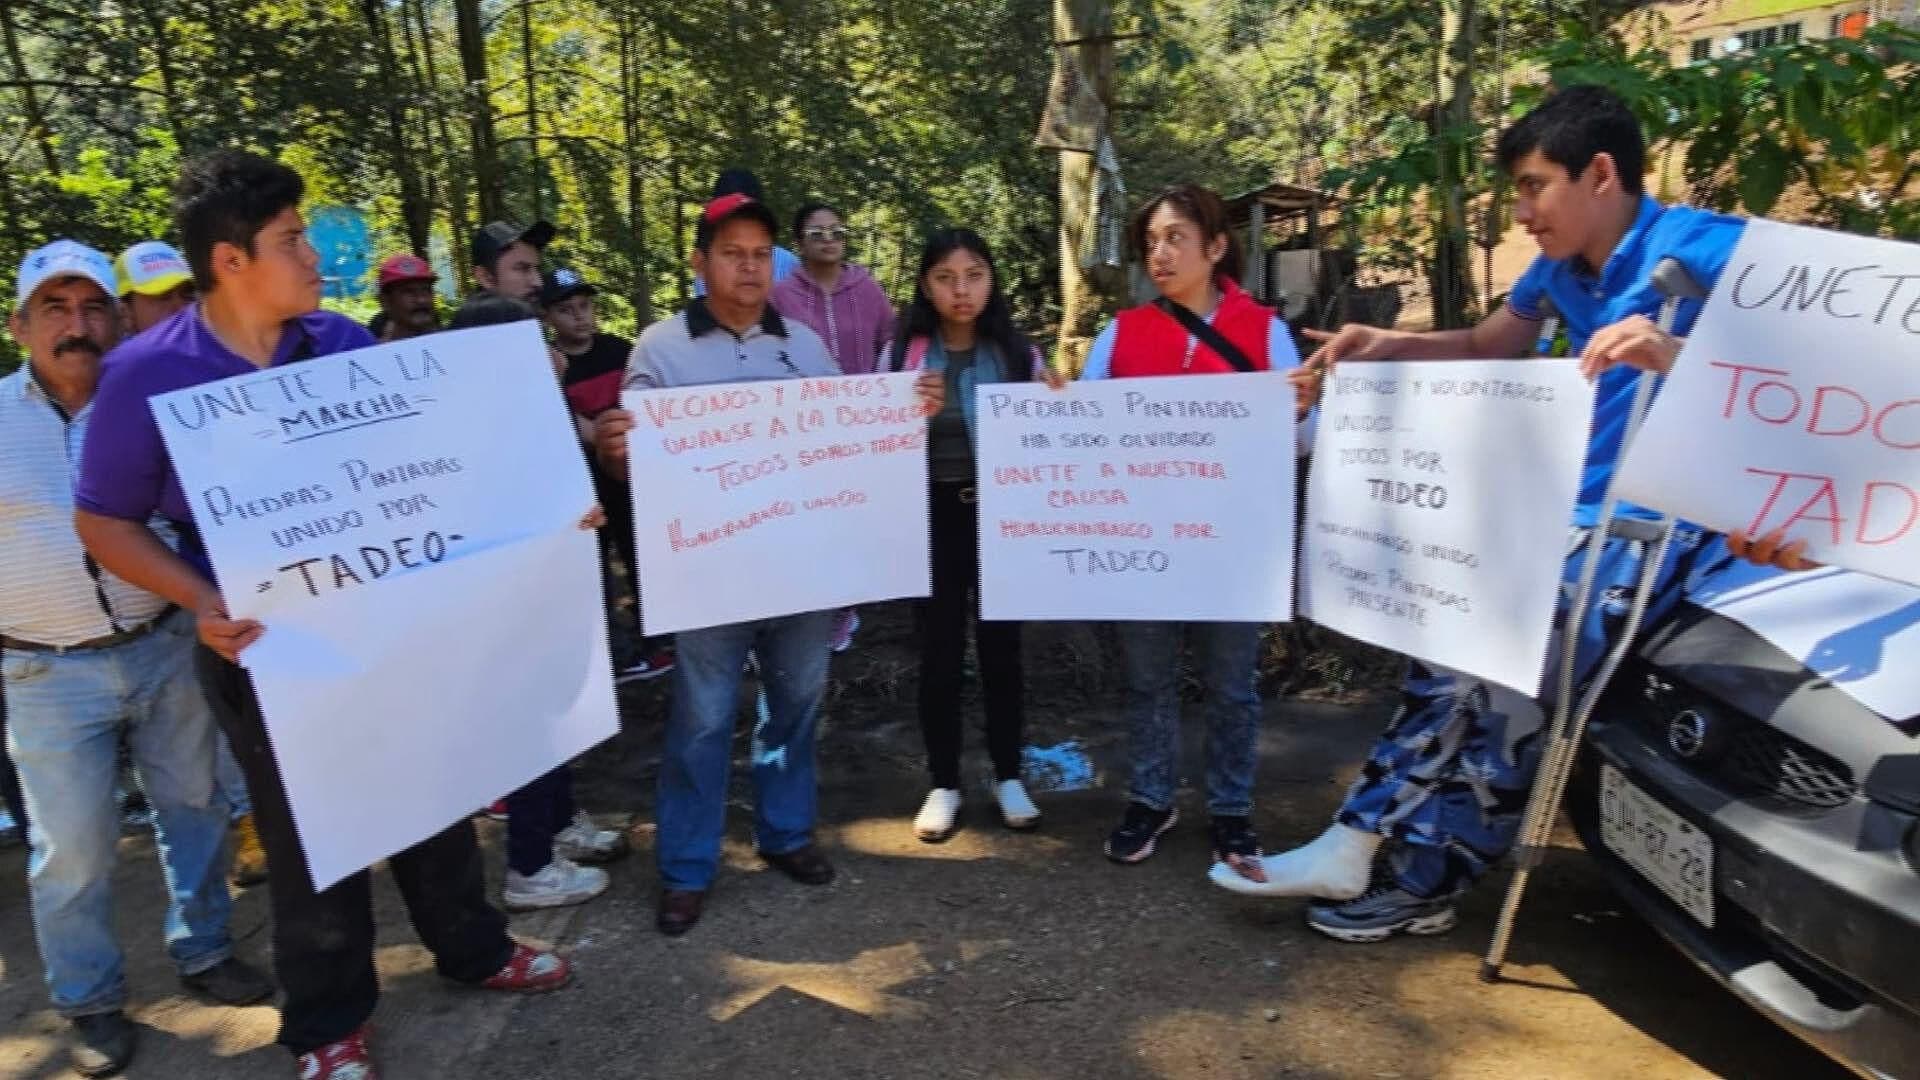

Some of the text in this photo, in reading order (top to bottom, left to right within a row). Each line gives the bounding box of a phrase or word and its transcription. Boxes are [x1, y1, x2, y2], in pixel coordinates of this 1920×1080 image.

[167, 348, 449, 431] UNETE A LA
[989, 391, 1250, 419] PIEDRAS PINTADAS
[768, 415, 788, 439] A
[796, 409, 824, 433] LA
[1020, 431, 1050, 448] HA
[1060, 433, 1112, 448] SIDO
[993, 460, 1227, 486] UNETE A NUESTRA
[1401, 448, 1445, 473] POR
[202, 457, 463, 528] PIEDRAS PINTADAS
[1047, 489, 1128, 508] CAUSA
[1366, 478, 1449, 510] TADEO
[270, 493, 438, 548] UNIDO POR
[1172, 522, 1219, 538] POR
[1048, 549, 1170, 576] TADEO
